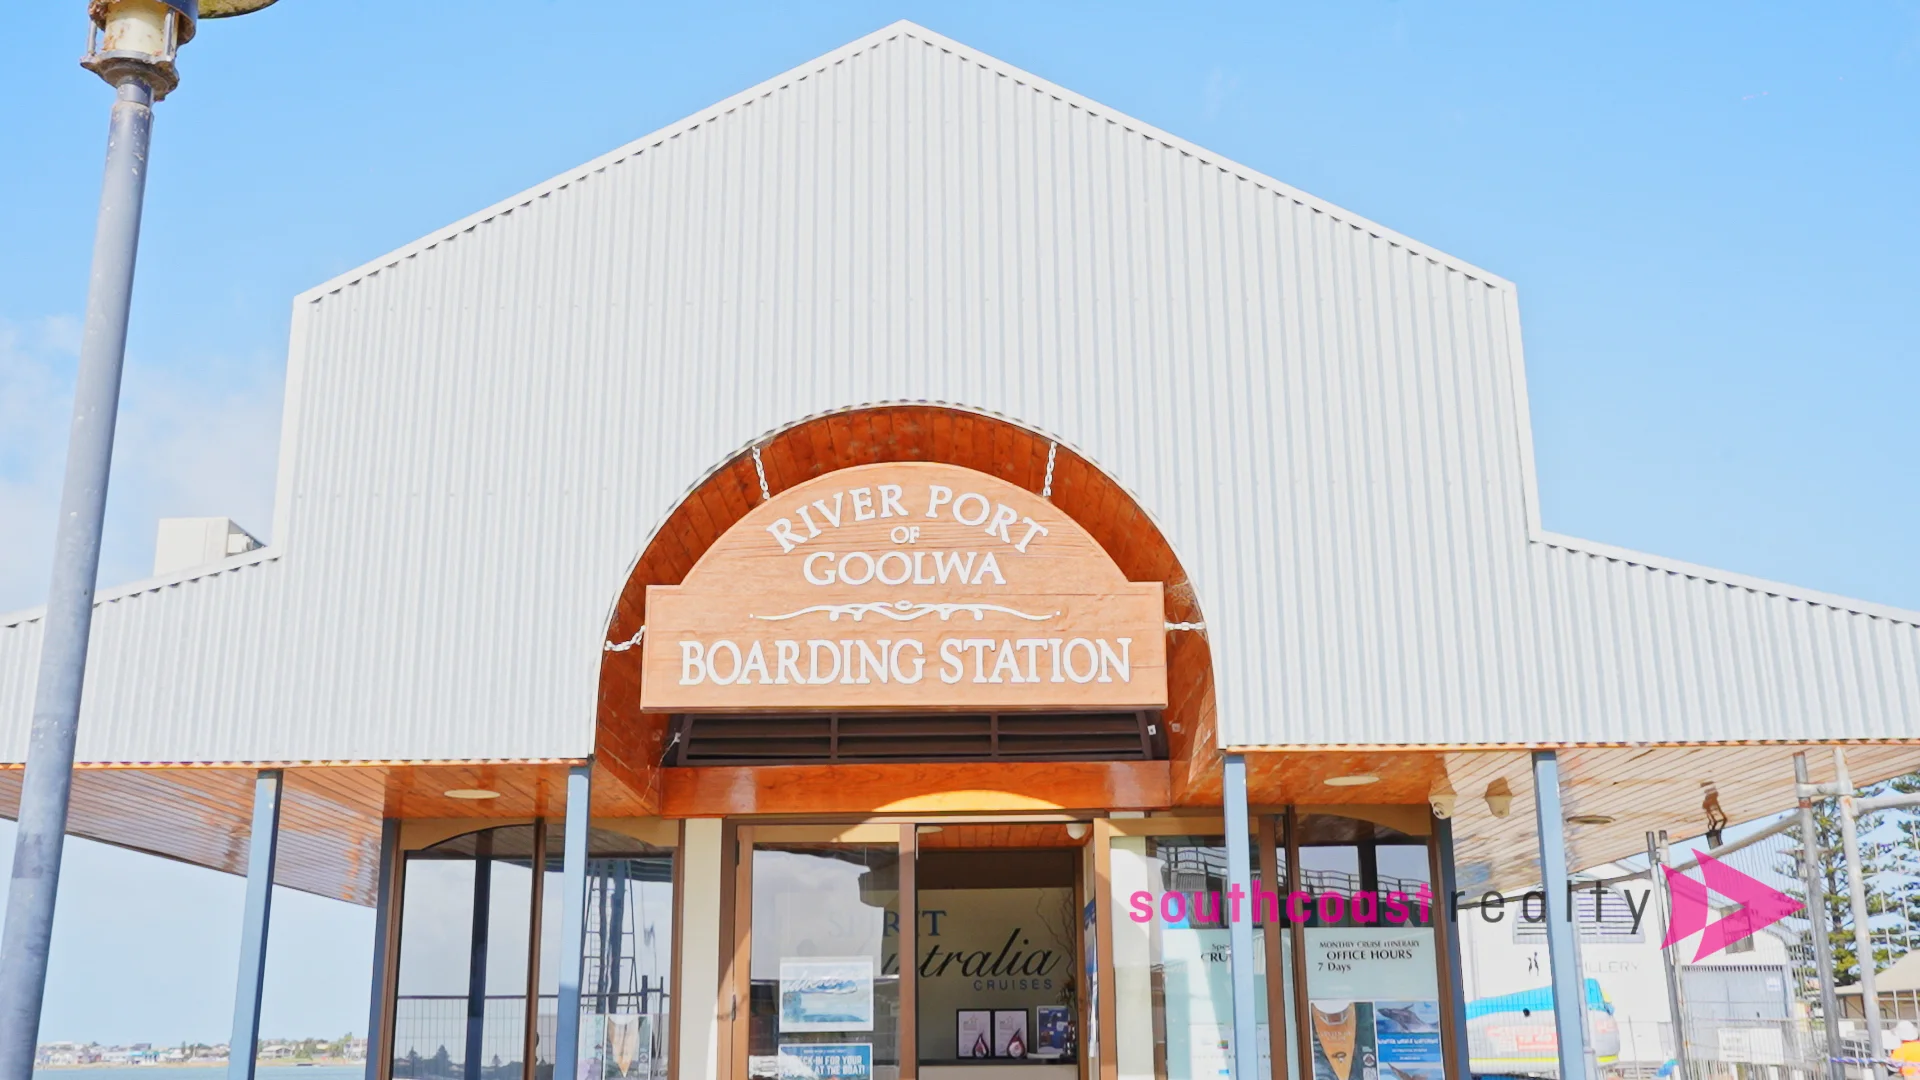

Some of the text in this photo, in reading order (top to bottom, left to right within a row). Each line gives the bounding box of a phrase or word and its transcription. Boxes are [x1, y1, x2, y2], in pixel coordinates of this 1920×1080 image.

[766, 484, 1048, 553] RIVER PORT
[890, 526, 920, 544] OF
[803, 552, 1006, 585] GOOLWA
[679, 637, 1132, 686] BOARDING STATION
[1319, 940, 1420, 949] MONTHLY CRUISE ITINERARY
[1327, 949, 1413, 960] OFFICE HOURS
[1318, 962, 1352, 974] 7 Days
[973, 979, 1053, 991] CRUISES
[825, 1055, 840, 1065] FOR
[842, 1055, 863, 1064] YOUR
[827, 1065, 840, 1074] THE
